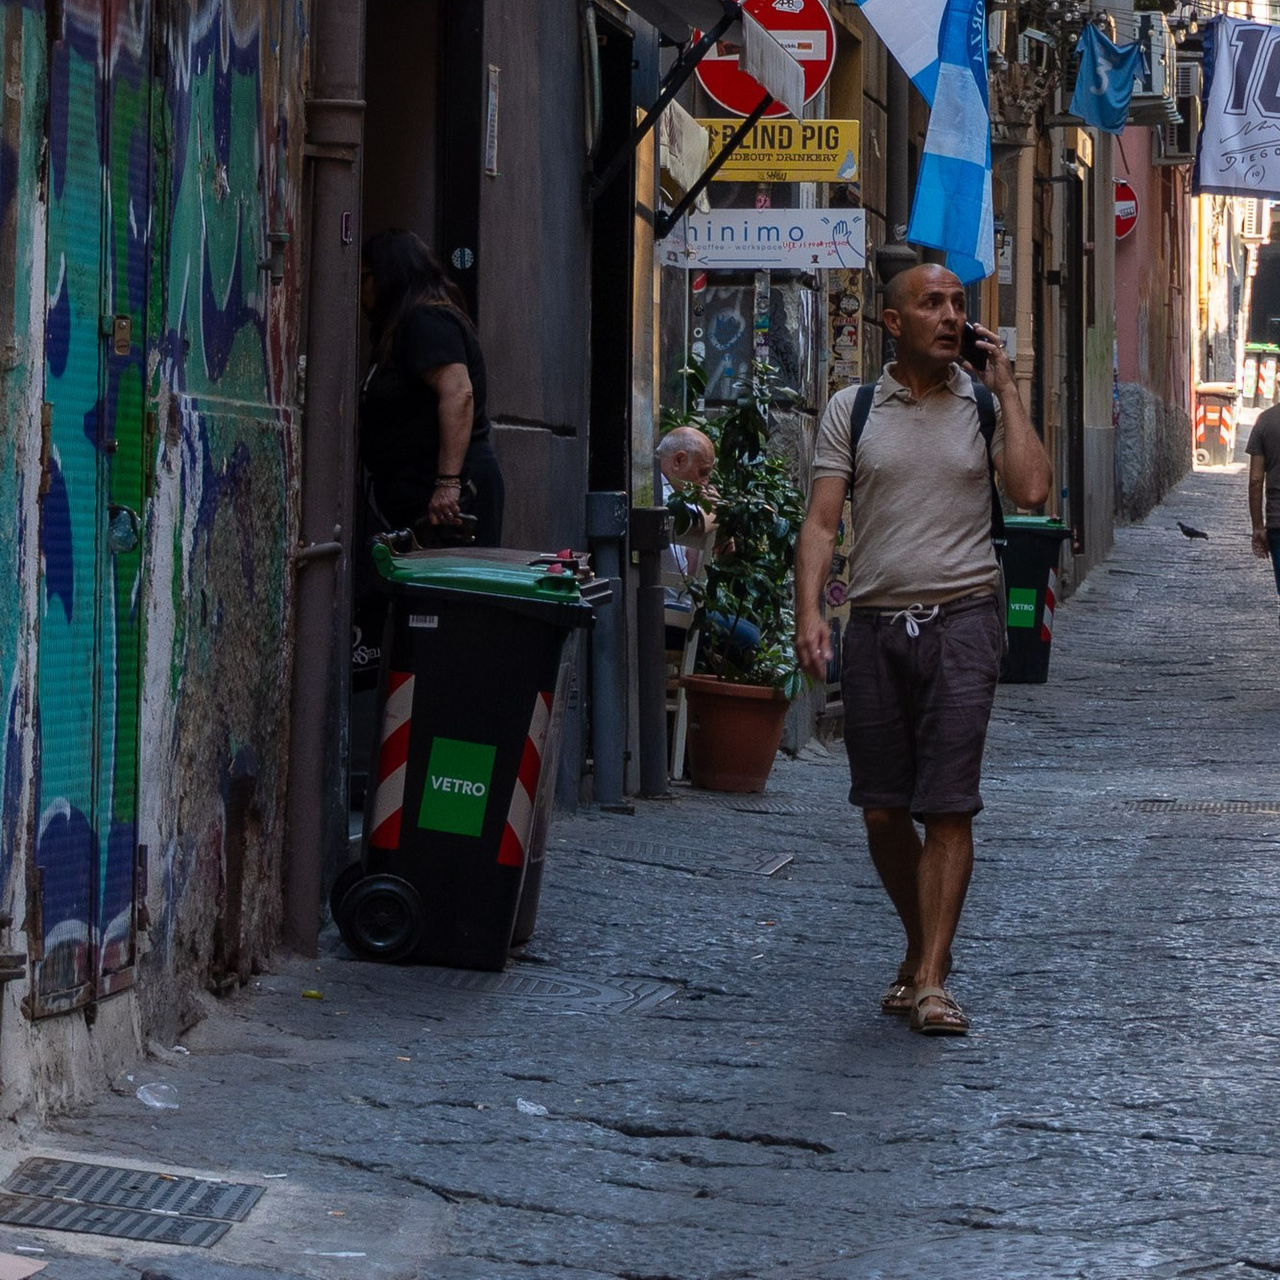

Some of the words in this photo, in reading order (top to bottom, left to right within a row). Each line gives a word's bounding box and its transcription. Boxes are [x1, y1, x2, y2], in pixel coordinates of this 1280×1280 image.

[801, 125, 840, 150] PIG
[726, 153, 773, 162] IDEOUT
[775, 153, 839, 162] DRINKERY
[735, 243, 783, 252] workspace
[1010, 603, 1034, 612] VETRO
[431, 775, 486, 797] VETRO
